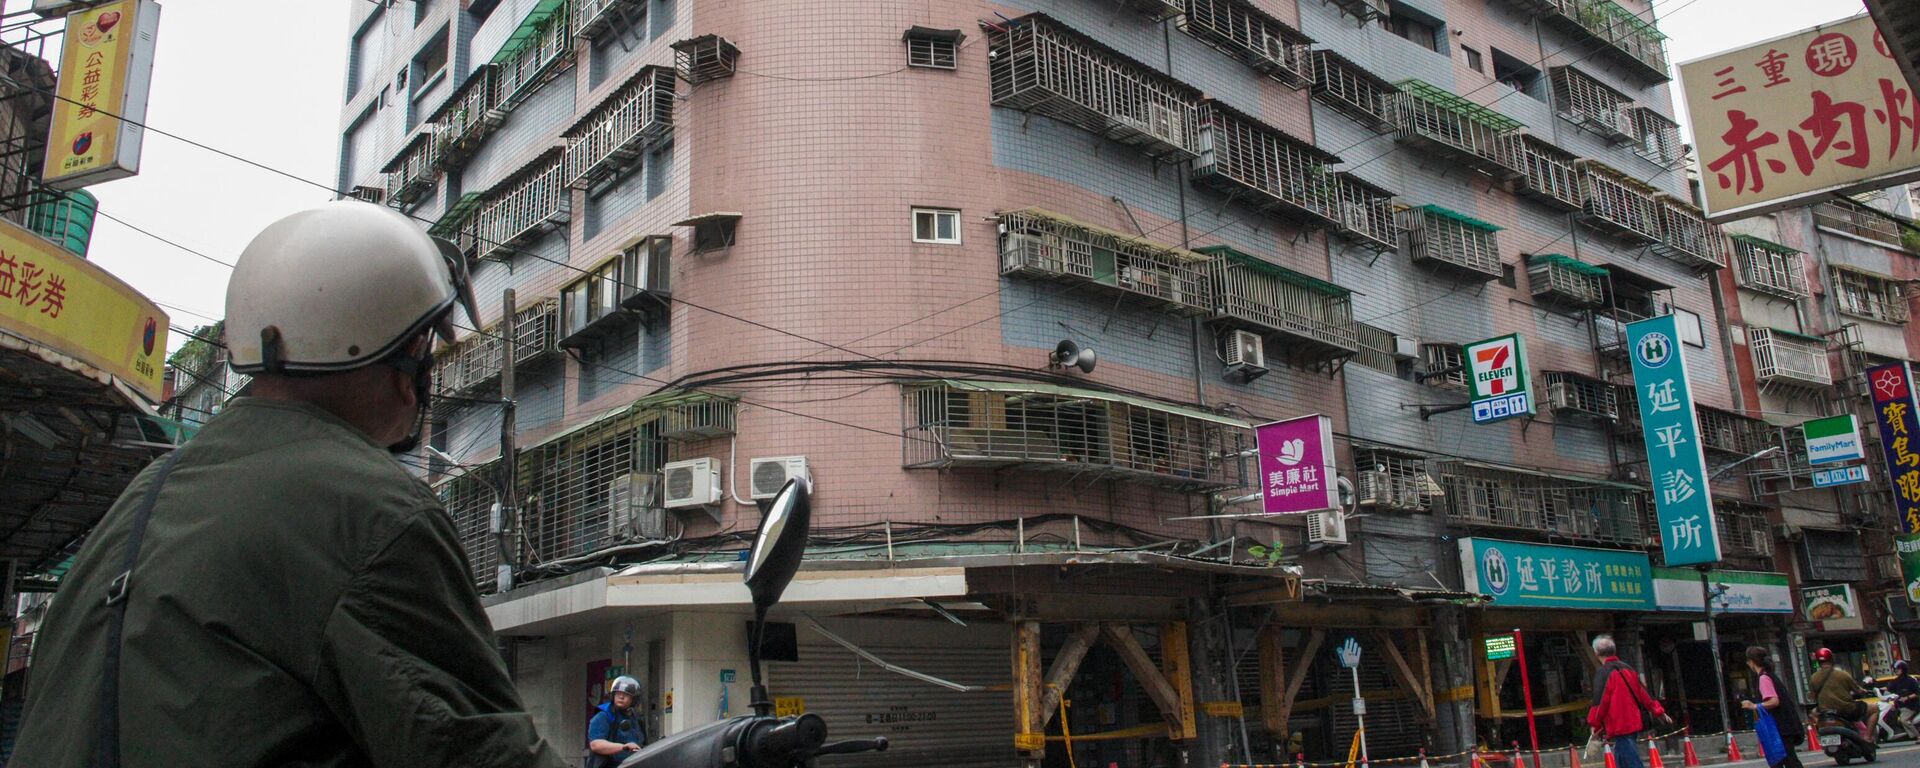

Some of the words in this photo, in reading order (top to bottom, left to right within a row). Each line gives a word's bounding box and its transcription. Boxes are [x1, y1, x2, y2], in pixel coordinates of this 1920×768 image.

[77, 51, 104, 120] 公益彩券
[1810, 440, 1856, 452] FamilyMart
[1645, 378, 1703, 551] 延平診所
[1833, 470, 1845, 481] ATM
[1269, 465, 1318, 487] 美廉社
[1270, 486, 1297, 497] Simple
[1299, 482, 1319, 493] Mart
[1515, 555, 1603, 594] 延平診所
